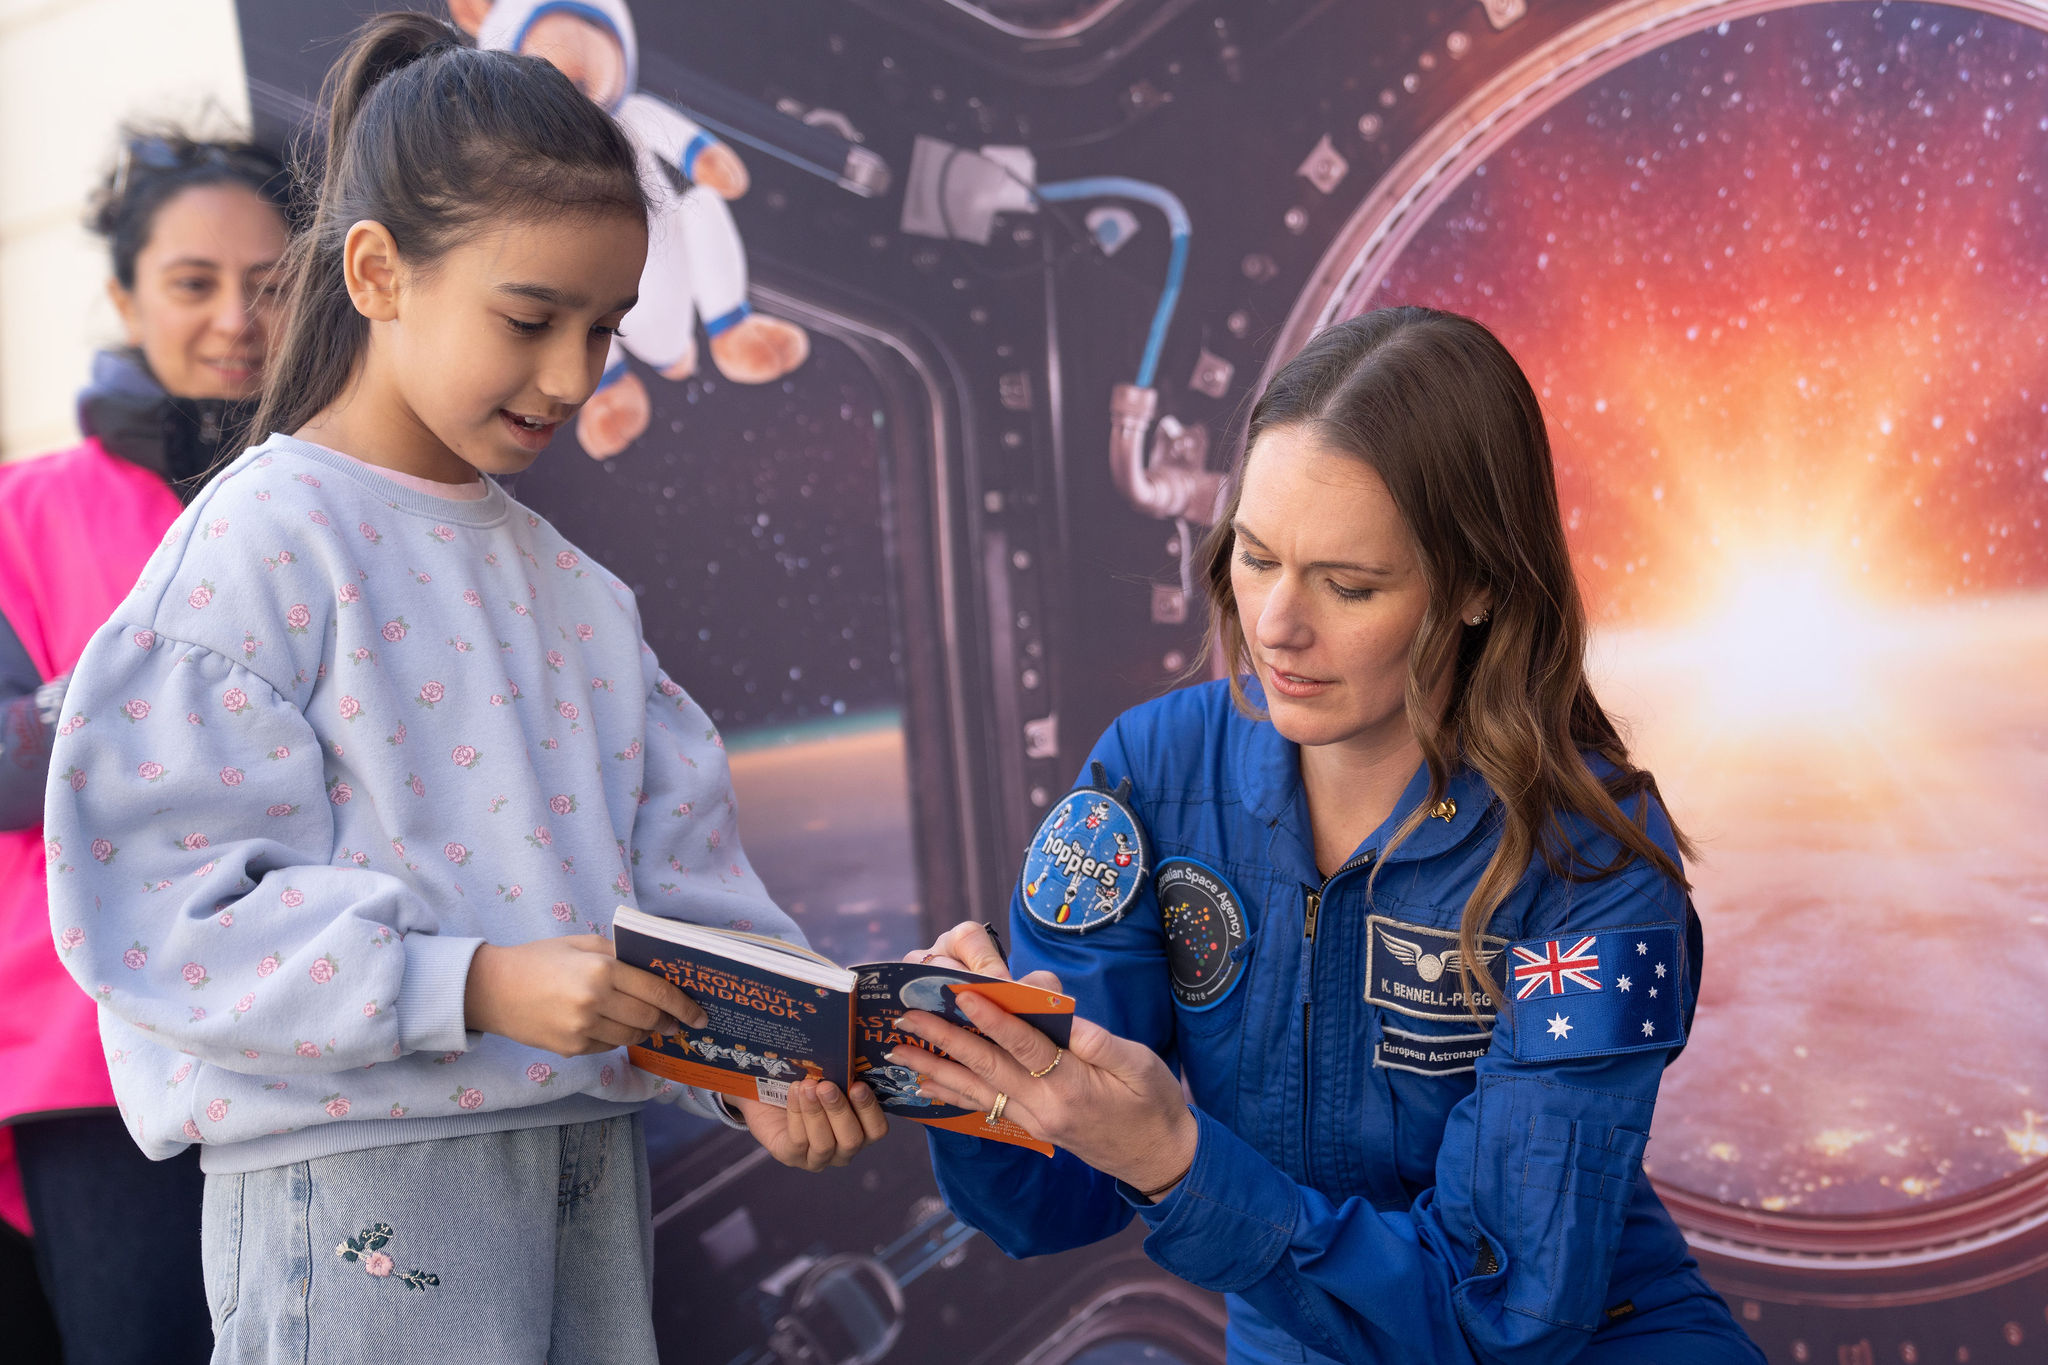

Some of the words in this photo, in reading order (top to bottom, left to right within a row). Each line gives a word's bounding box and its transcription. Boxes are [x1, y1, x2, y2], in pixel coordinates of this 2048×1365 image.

[1041, 829, 1119, 887] hoppers
[1072, 840, 1086, 857] the
[1185, 867, 1219, 894] Space
[1216, 891, 1242, 939] Agency
[650, 958, 817, 1014] ASTRONAUT'S
[664, 972, 802, 1021] HANDBOOK
[675, 958, 694, 968] THE
[696, 964, 740, 982] USBORNE
[742, 978, 790, 997] OFFICIAL
[1186, 992, 1206, 1001] 2018
[1381, 978, 1392, 994] K.
[1383, 1041, 1426, 1061] European
[1428, 1047, 1486, 1063] Astronaut
